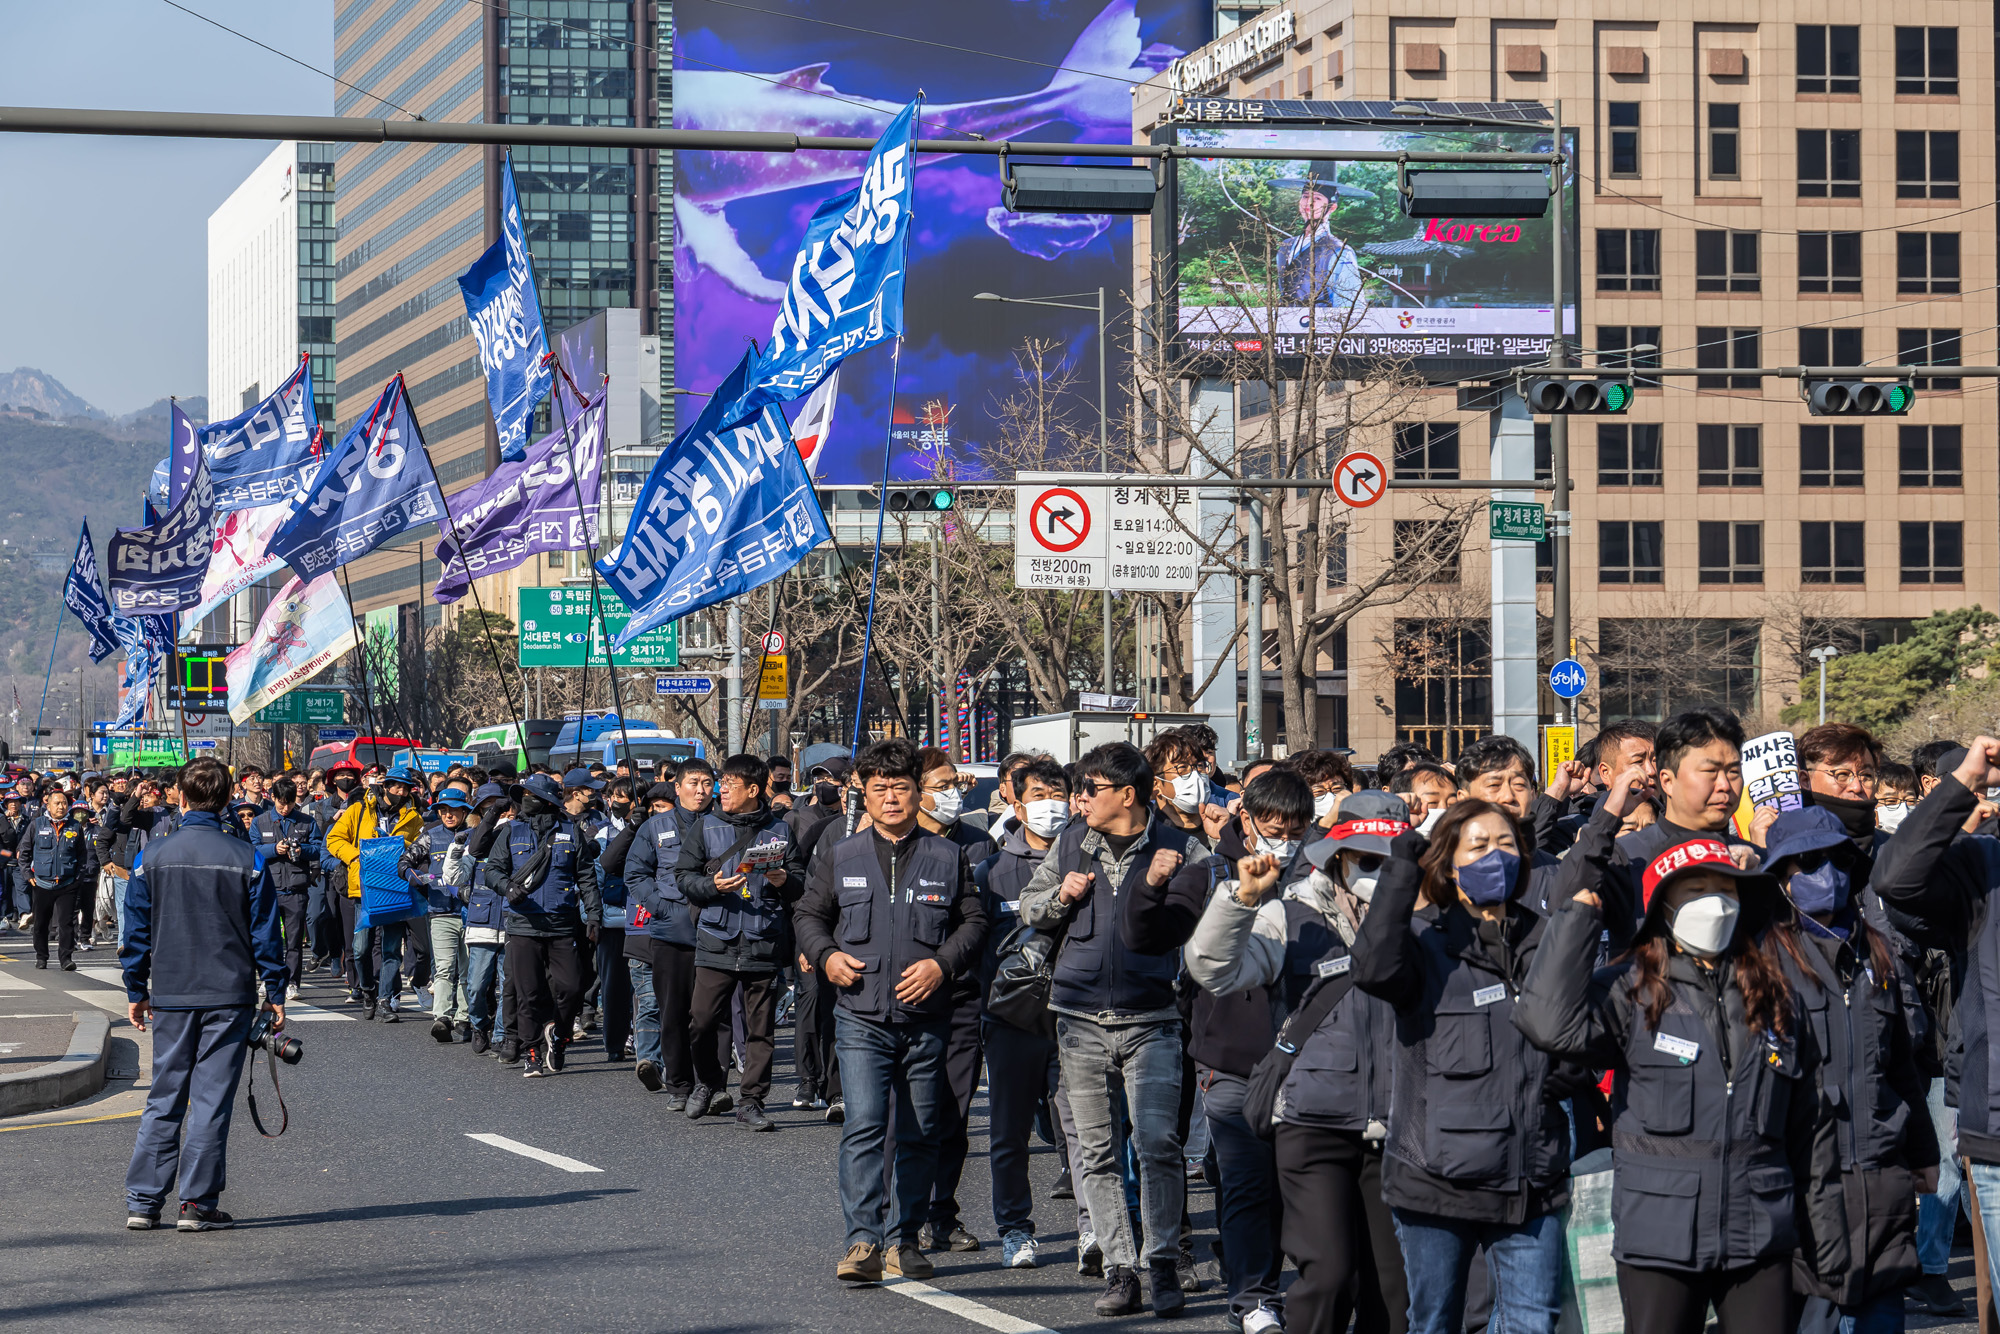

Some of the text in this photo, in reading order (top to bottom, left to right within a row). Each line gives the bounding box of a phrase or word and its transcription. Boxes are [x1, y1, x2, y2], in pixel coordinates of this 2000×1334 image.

[1183, 9, 1294, 91] SEOUL FINANCE CENTER
[1183, 101, 1264, 121] 서울신문
[1423, 217, 1521, 243] Korea
[1503, 507, 1542, 525] 청계광장
[1031, 558, 1091, 574] 전방200m
[1031, 574, 1091, 587] (자전거 허용)
[522, 632, 561, 642] 서대문역
[630, 645, 665, 655] 청계1가
[306, 698, 334, 707] 청계1가
[1748, 770, 1801, 804] 원청
[1654, 847, 1689, 879] 단결
